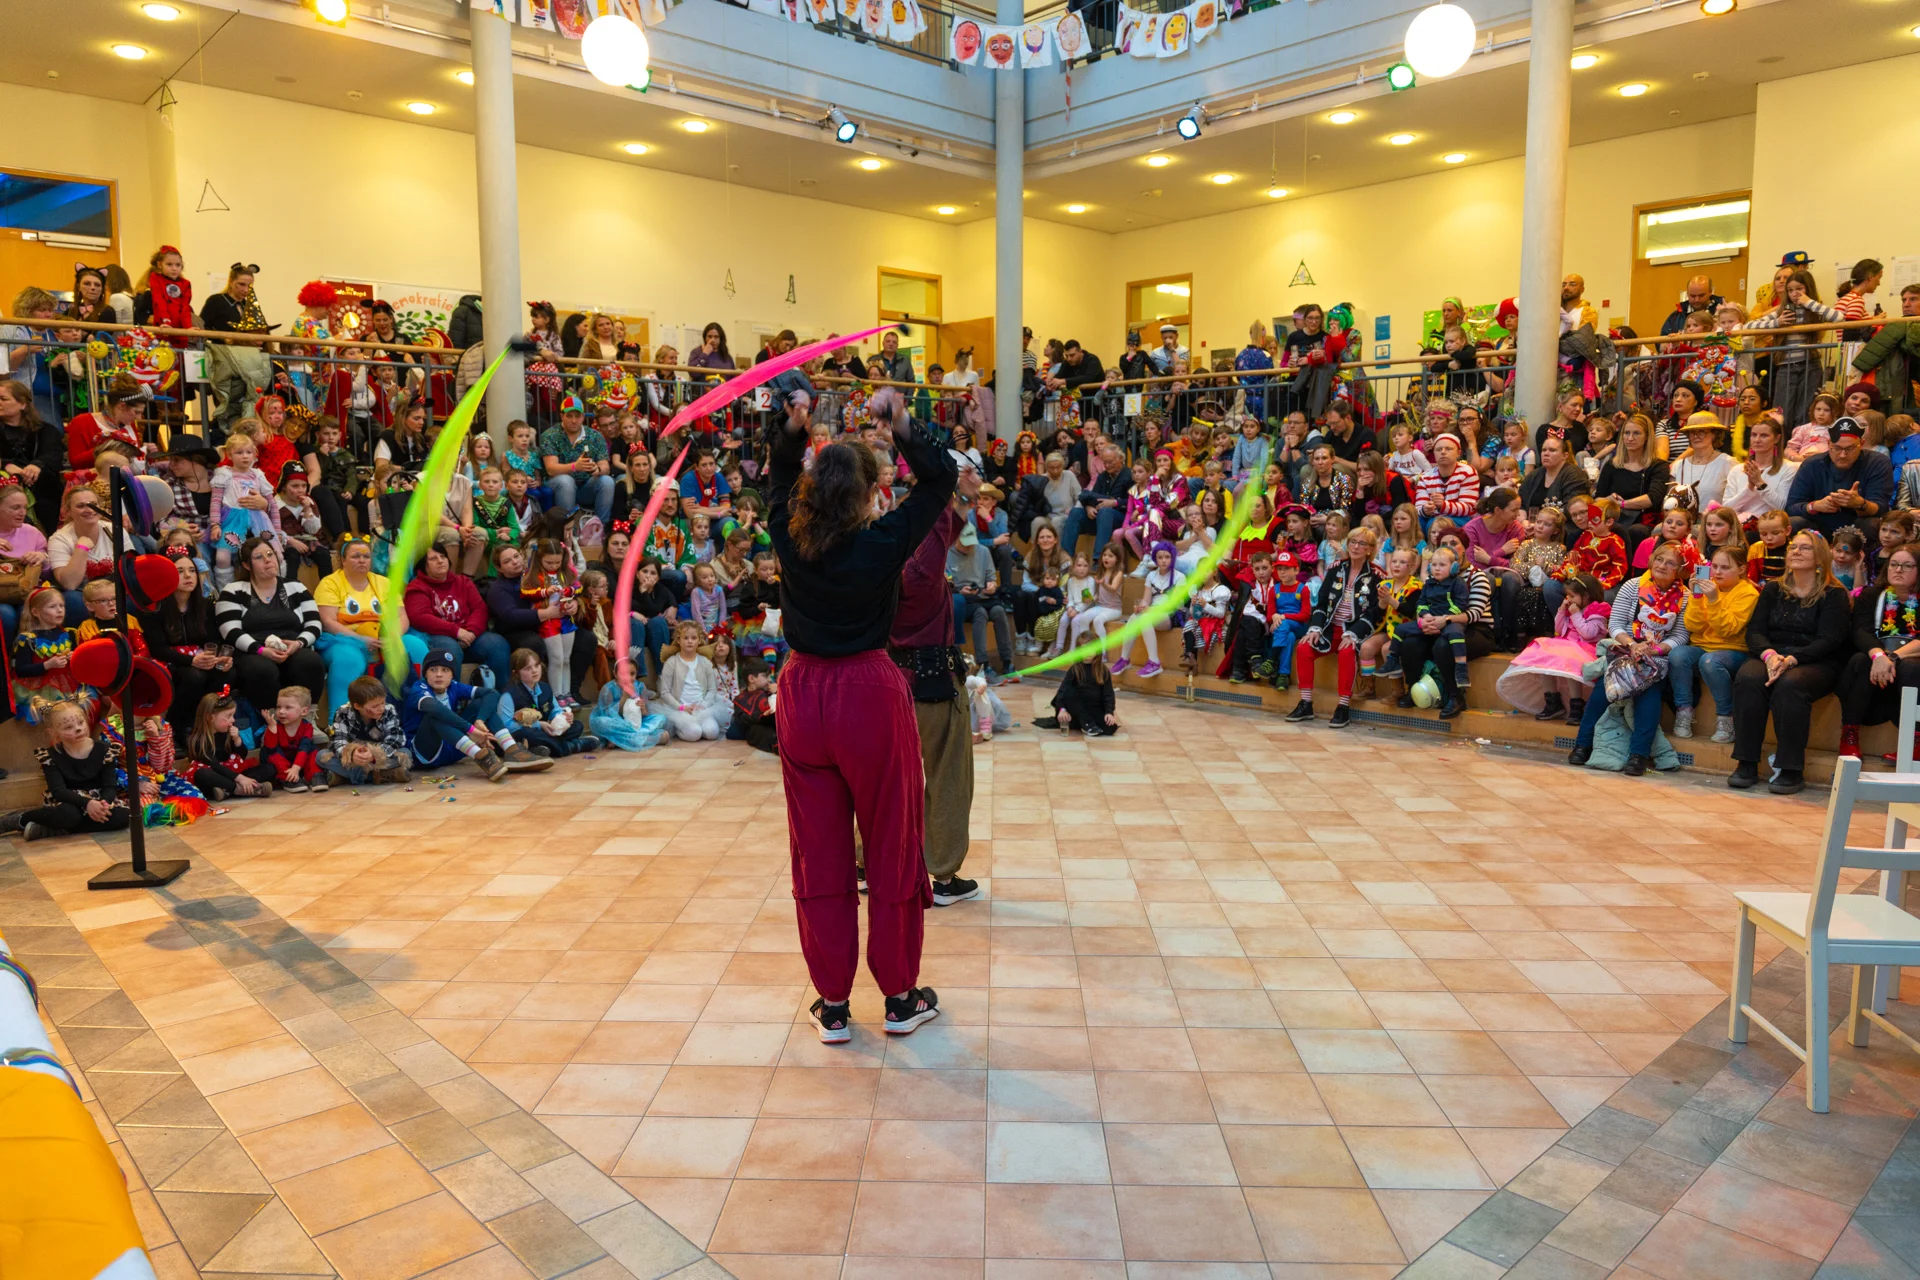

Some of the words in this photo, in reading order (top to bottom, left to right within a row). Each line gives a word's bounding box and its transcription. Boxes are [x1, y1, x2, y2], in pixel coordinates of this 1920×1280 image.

[391, 292, 453, 311] emokratie
[194, 357, 208, 379] 1
[761, 391, 772, 409] 2
[1127, 397, 1137, 414] 3
